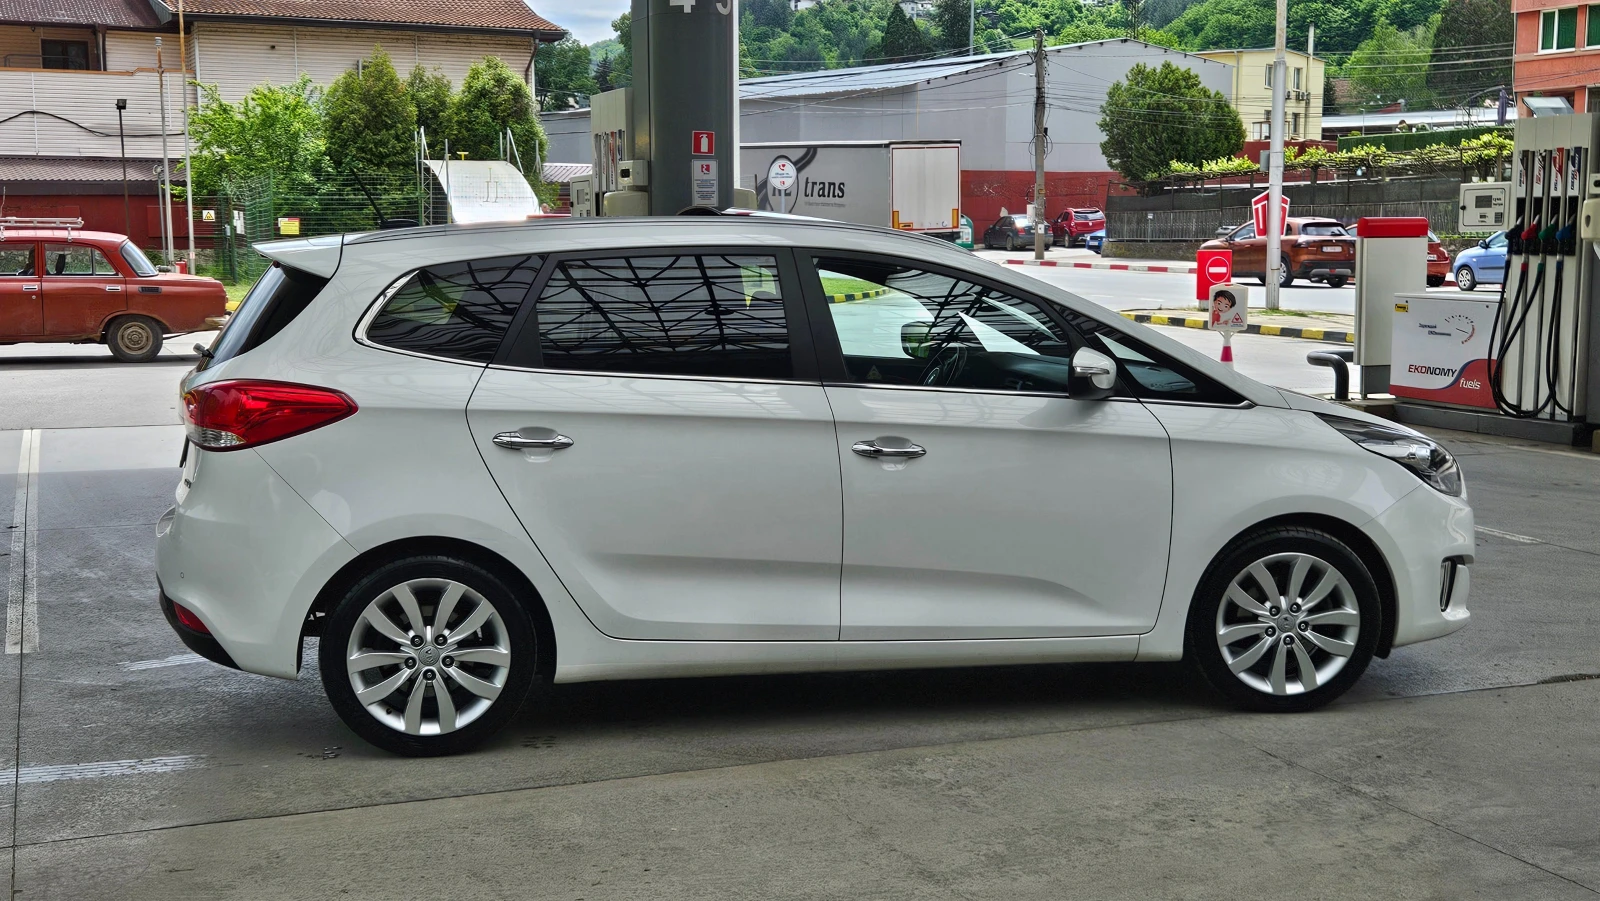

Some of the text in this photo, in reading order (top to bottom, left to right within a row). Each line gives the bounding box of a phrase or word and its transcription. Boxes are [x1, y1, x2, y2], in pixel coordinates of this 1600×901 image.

[804, 176, 846, 199] trans
[1408, 364, 1458, 378] EKONOMY
[1459, 377, 1481, 390] fuels
